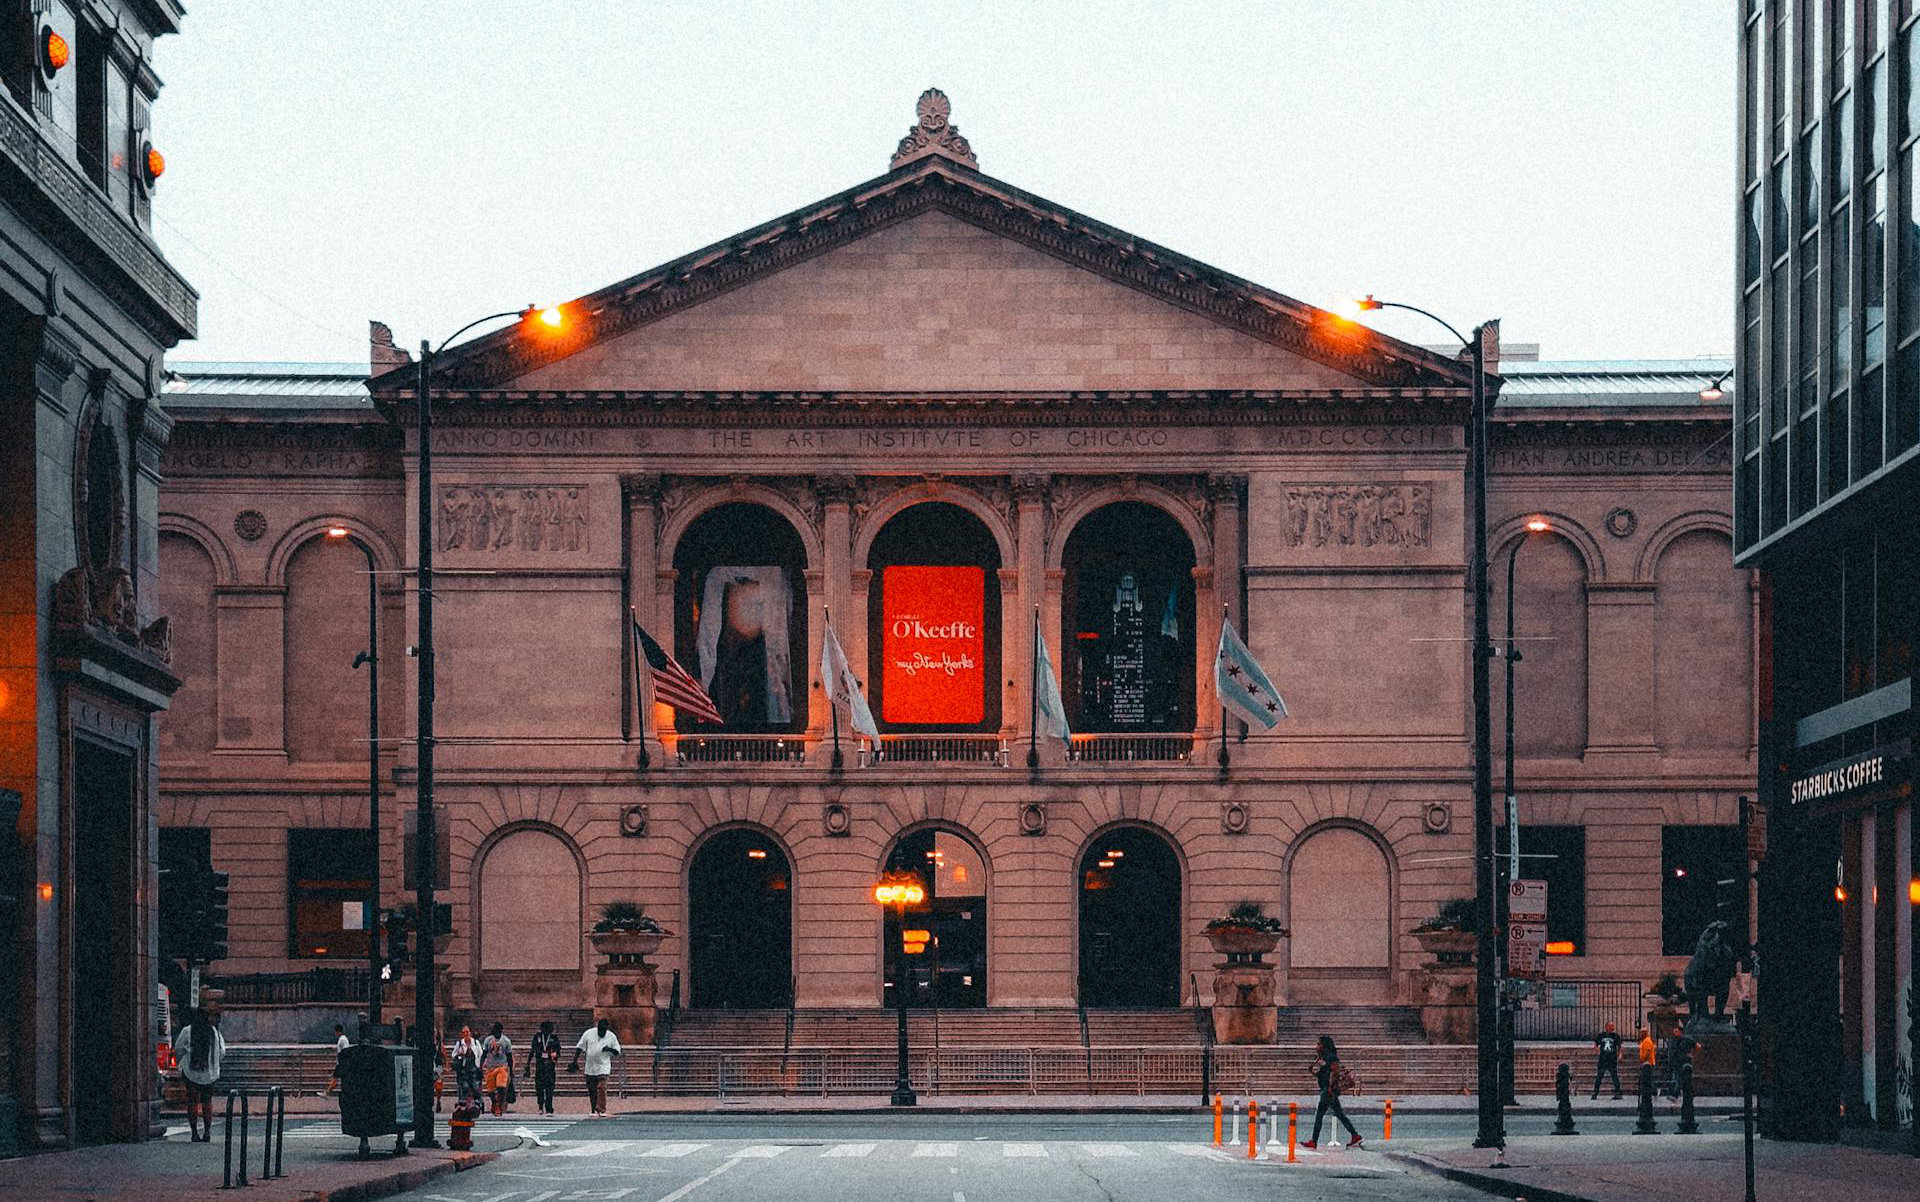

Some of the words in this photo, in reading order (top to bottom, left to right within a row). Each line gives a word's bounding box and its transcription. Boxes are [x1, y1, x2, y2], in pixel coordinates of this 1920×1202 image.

[435, 431, 498, 447] ANNO
[510, 430, 594, 447] DOMINI
[709, 430, 753, 447] THE
[785, 430, 827, 447] ART
[858, 430, 981, 447] INSTITVTE
[1009, 430, 1041, 446] OF
[1067, 430, 1169, 447] CHICAGO
[1279, 428, 1435, 446] MDCCCXCII
[1563, 449, 1645, 466] ANDREA
[1656, 449, 1690, 466] DEL
[892, 620, 976, 638] O'Keeffe
[913, 652, 944, 669] New
[1791, 767, 1845, 805] STARBUCKS
[1847, 756, 1883, 790] COFFEE
